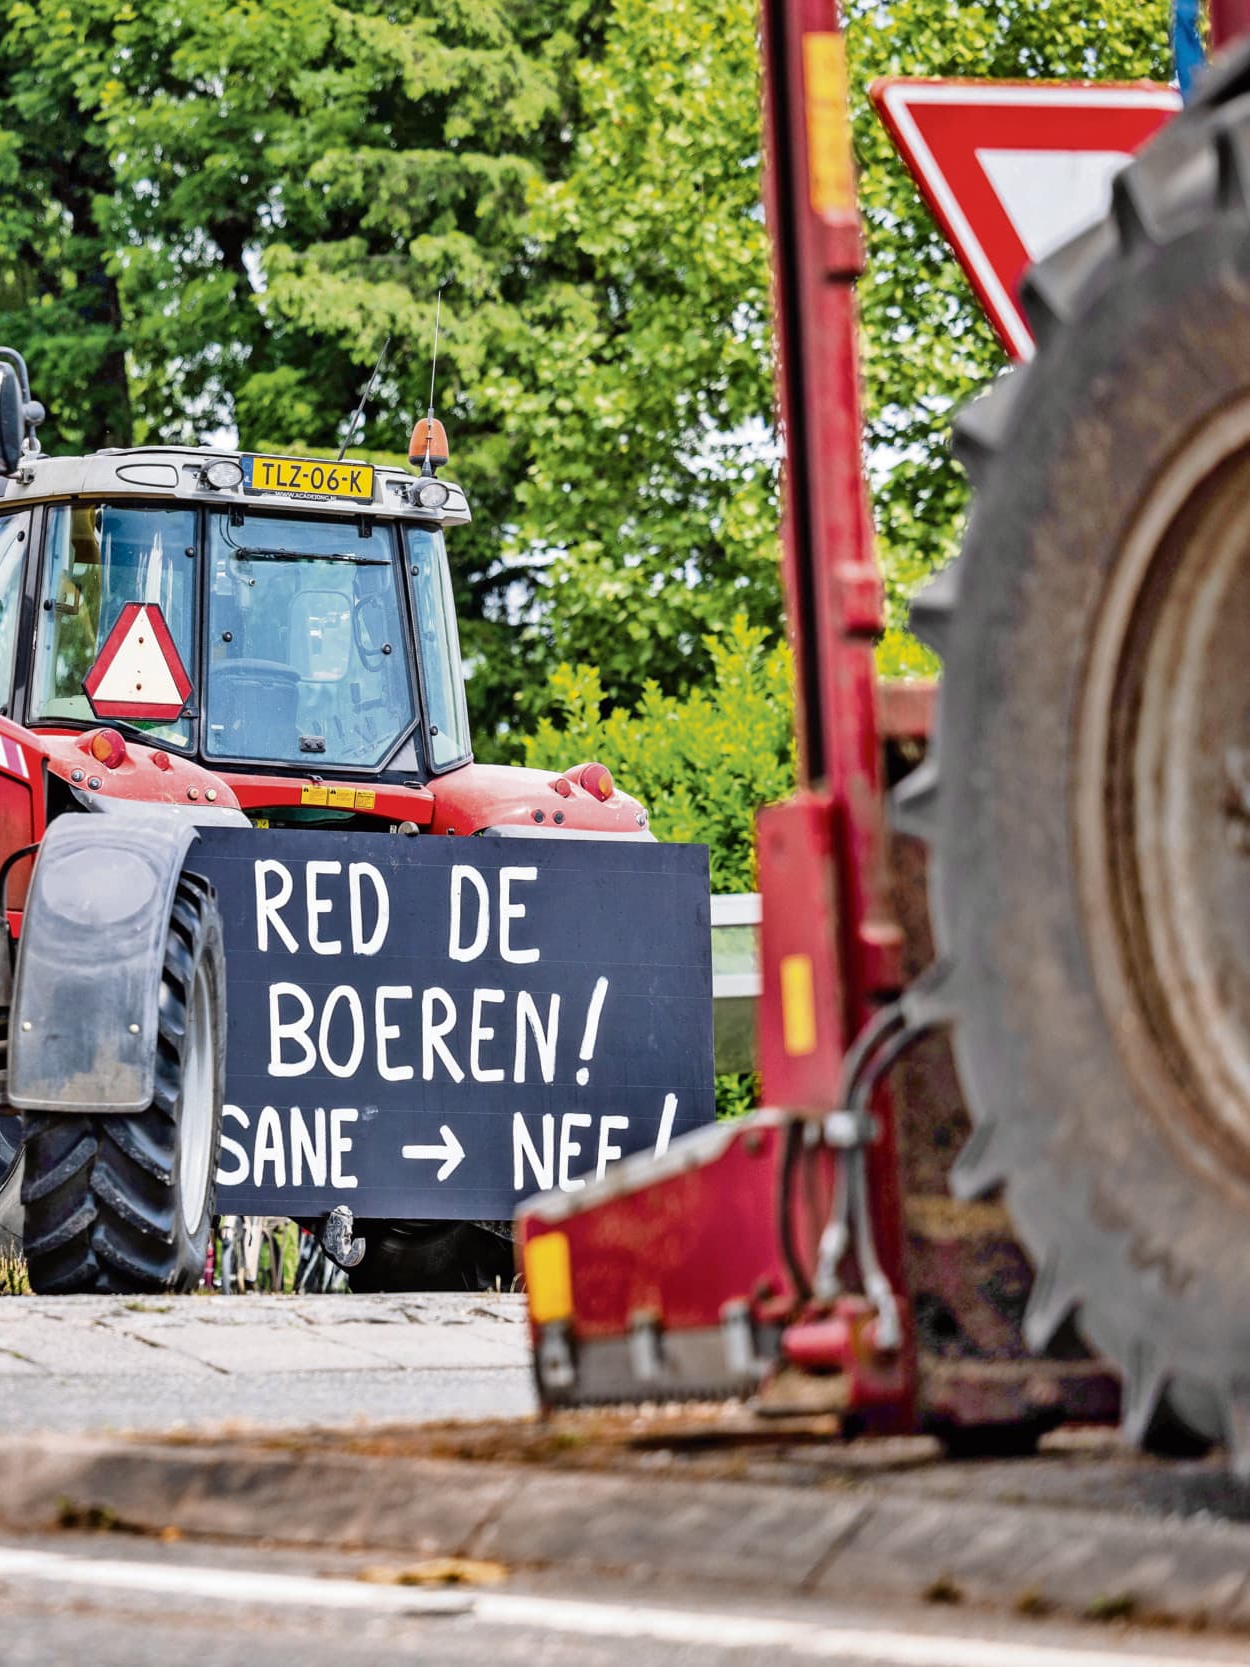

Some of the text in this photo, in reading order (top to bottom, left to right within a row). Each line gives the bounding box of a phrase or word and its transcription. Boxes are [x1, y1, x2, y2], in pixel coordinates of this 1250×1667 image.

[261, 463, 363, 493] TLZ-06-K
[254, 859, 541, 964] RED DE
[268, 976, 609, 1086] BOEREN!
[215, 1104, 359, 1188] SANE
